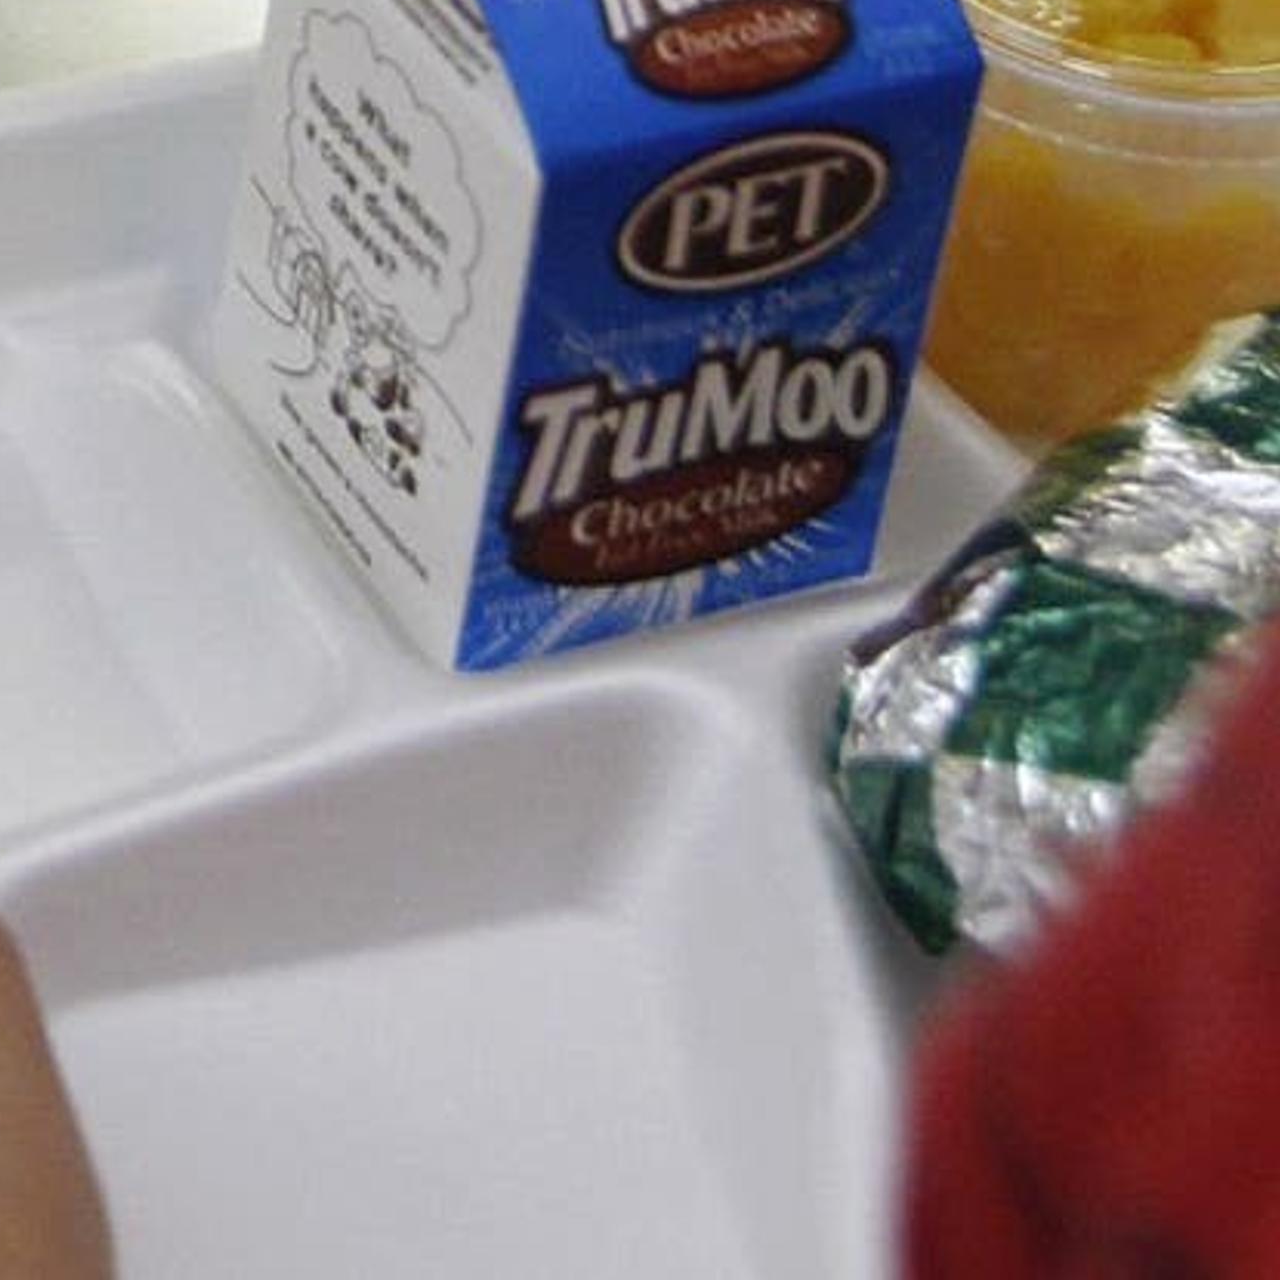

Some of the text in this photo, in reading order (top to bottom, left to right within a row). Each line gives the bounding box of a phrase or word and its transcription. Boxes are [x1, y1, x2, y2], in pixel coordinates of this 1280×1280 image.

[653, 8, 819, 64] Chocolate
[662, 160, 850, 271] PET
[511, 346, 890, 523] TruMoo
[571, 458, 825, 546] Chocolate
